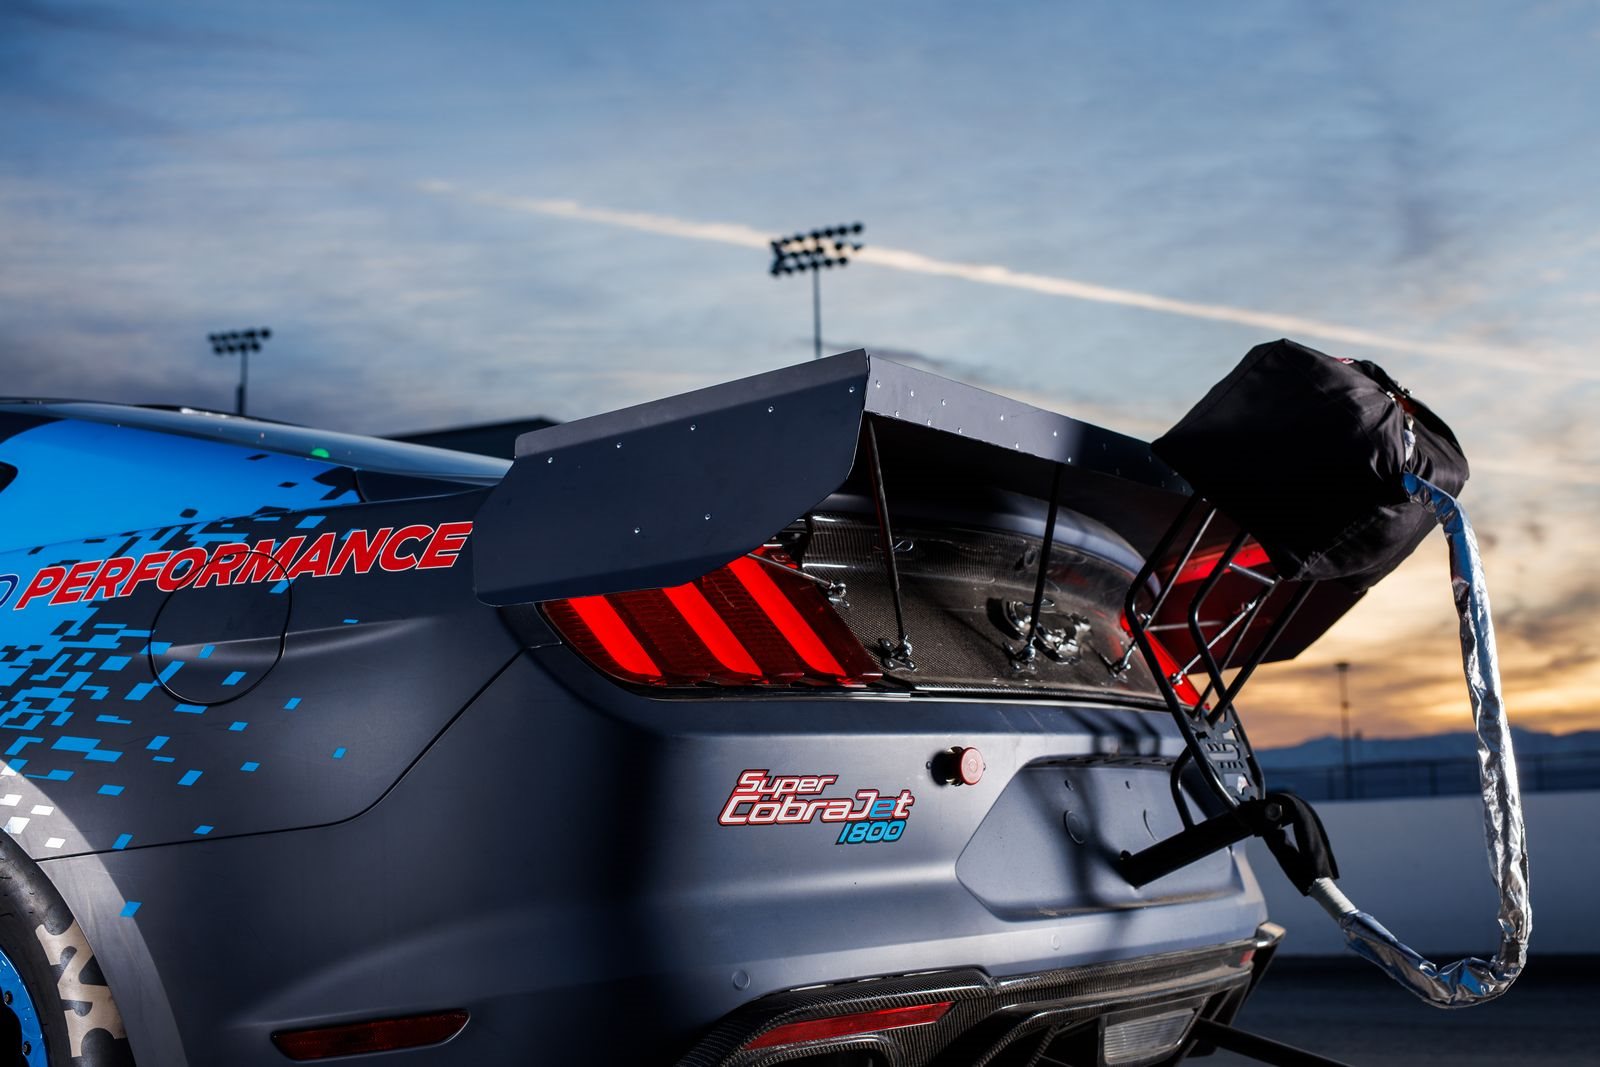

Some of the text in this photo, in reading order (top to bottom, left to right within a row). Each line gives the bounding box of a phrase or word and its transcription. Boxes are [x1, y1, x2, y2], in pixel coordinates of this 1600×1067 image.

[13, 521, 474, 611] PERFORMANCE
[736, 769, 838, 799] Super
[718, 789, 915, 826] CobraJet
[835, 820, 906, 845] 1800
